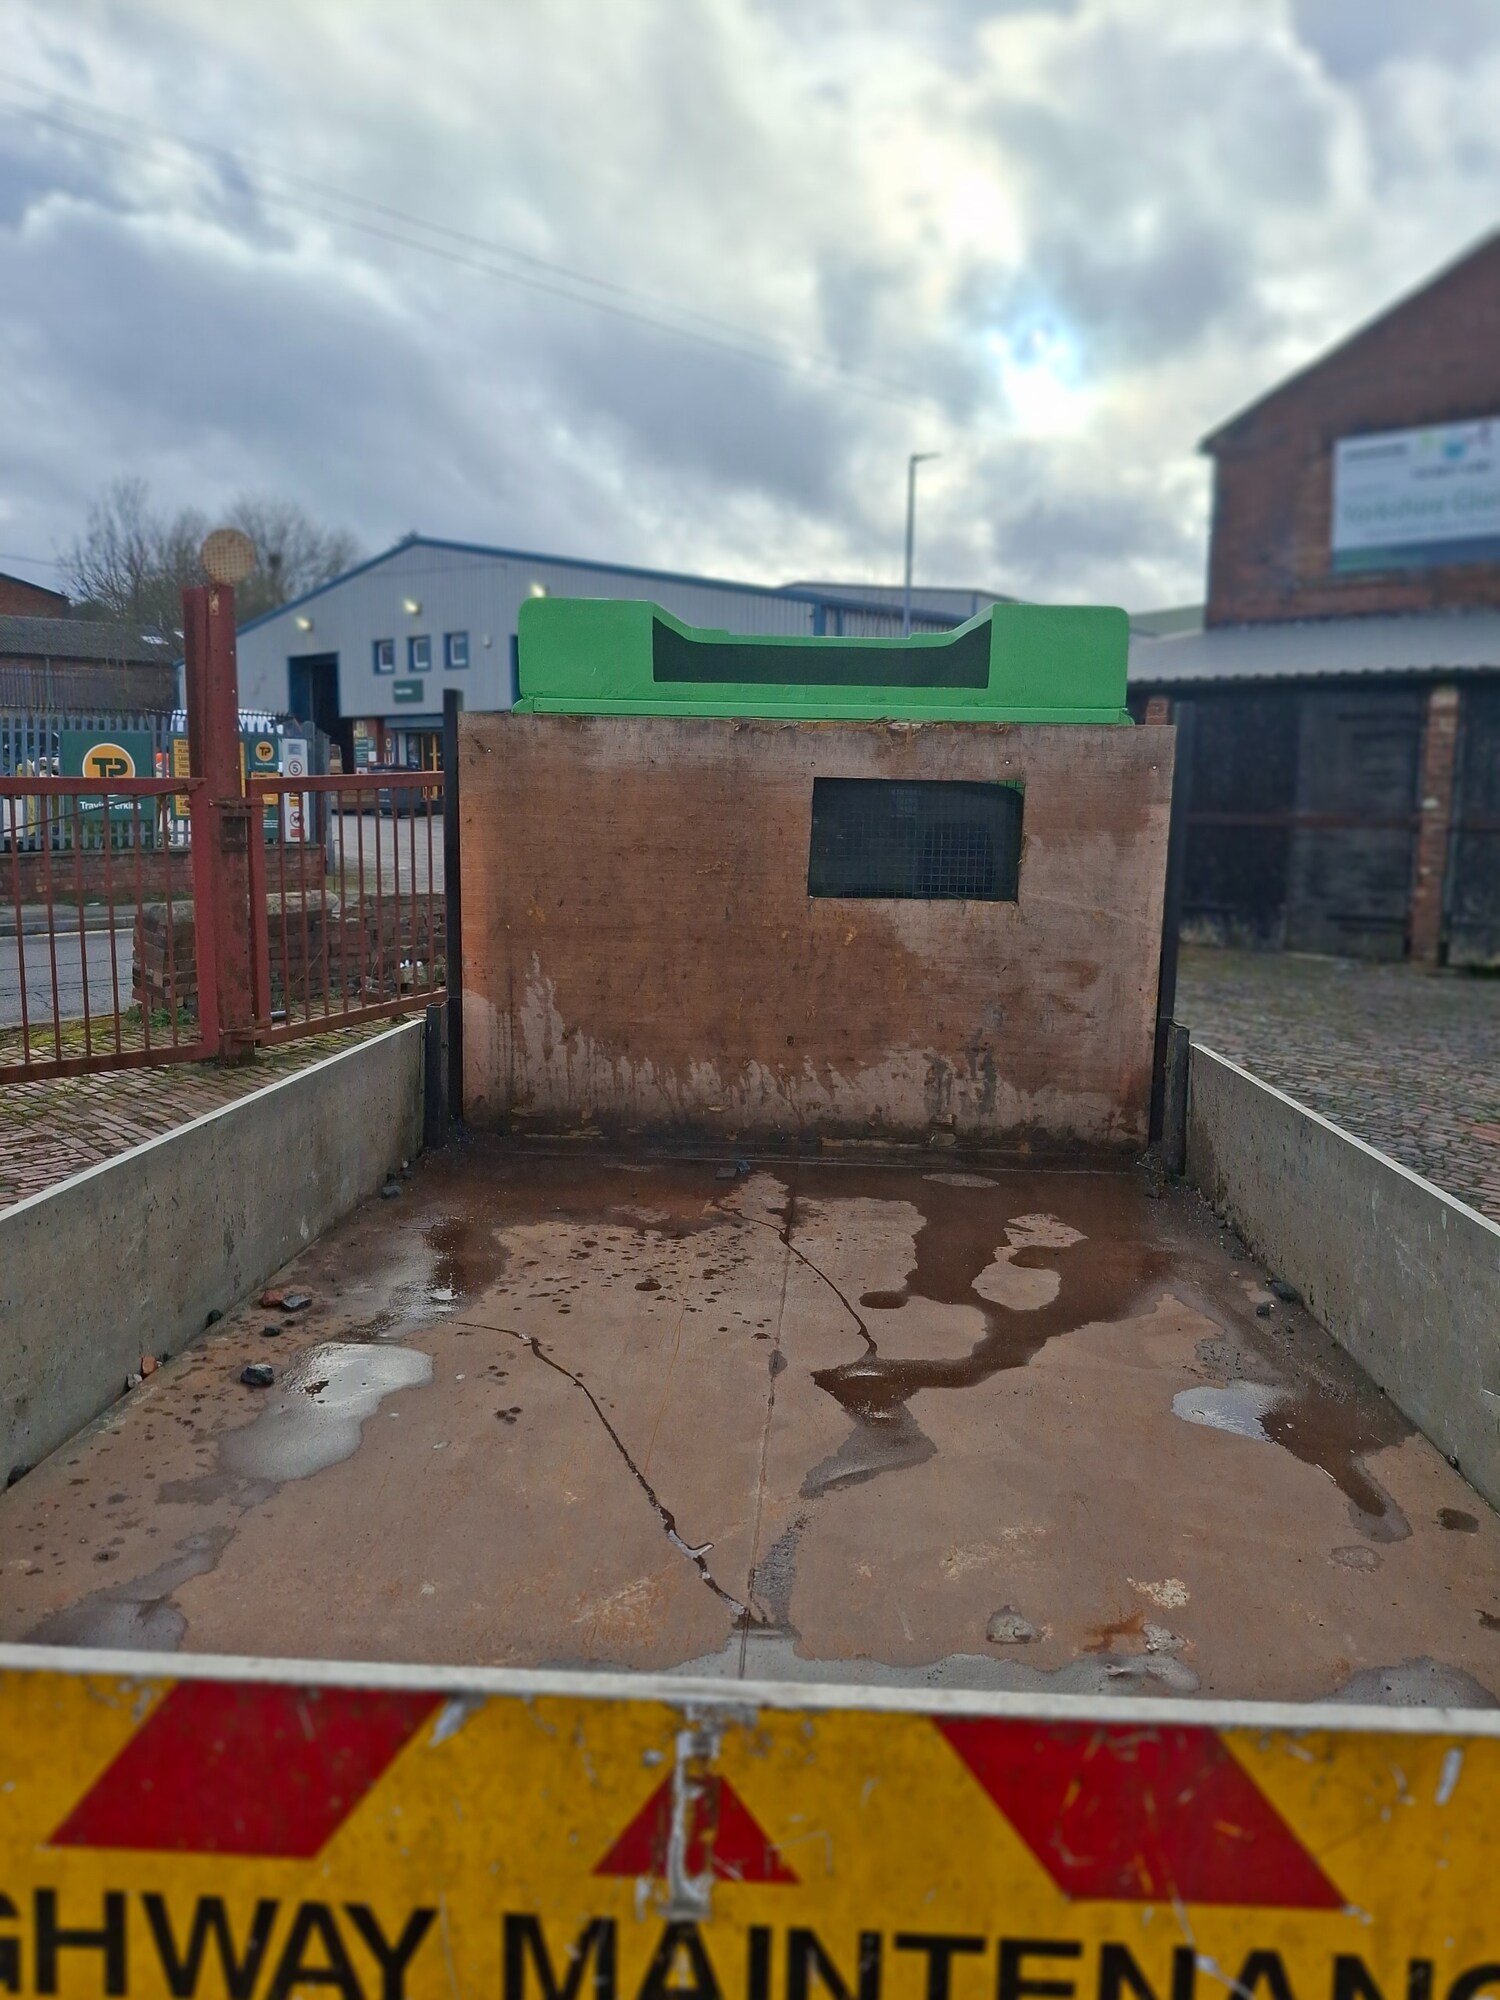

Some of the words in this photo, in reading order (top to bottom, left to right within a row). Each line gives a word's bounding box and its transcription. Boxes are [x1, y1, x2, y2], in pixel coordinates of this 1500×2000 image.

[259, 746, 271, 756] TP
[92, 757, 128, 778] TP
[292, 764, 299, 773] 5
[0, 1887, 438, 2000] HWAY
[503, 1911, 1500, 2000] MAINTEN
